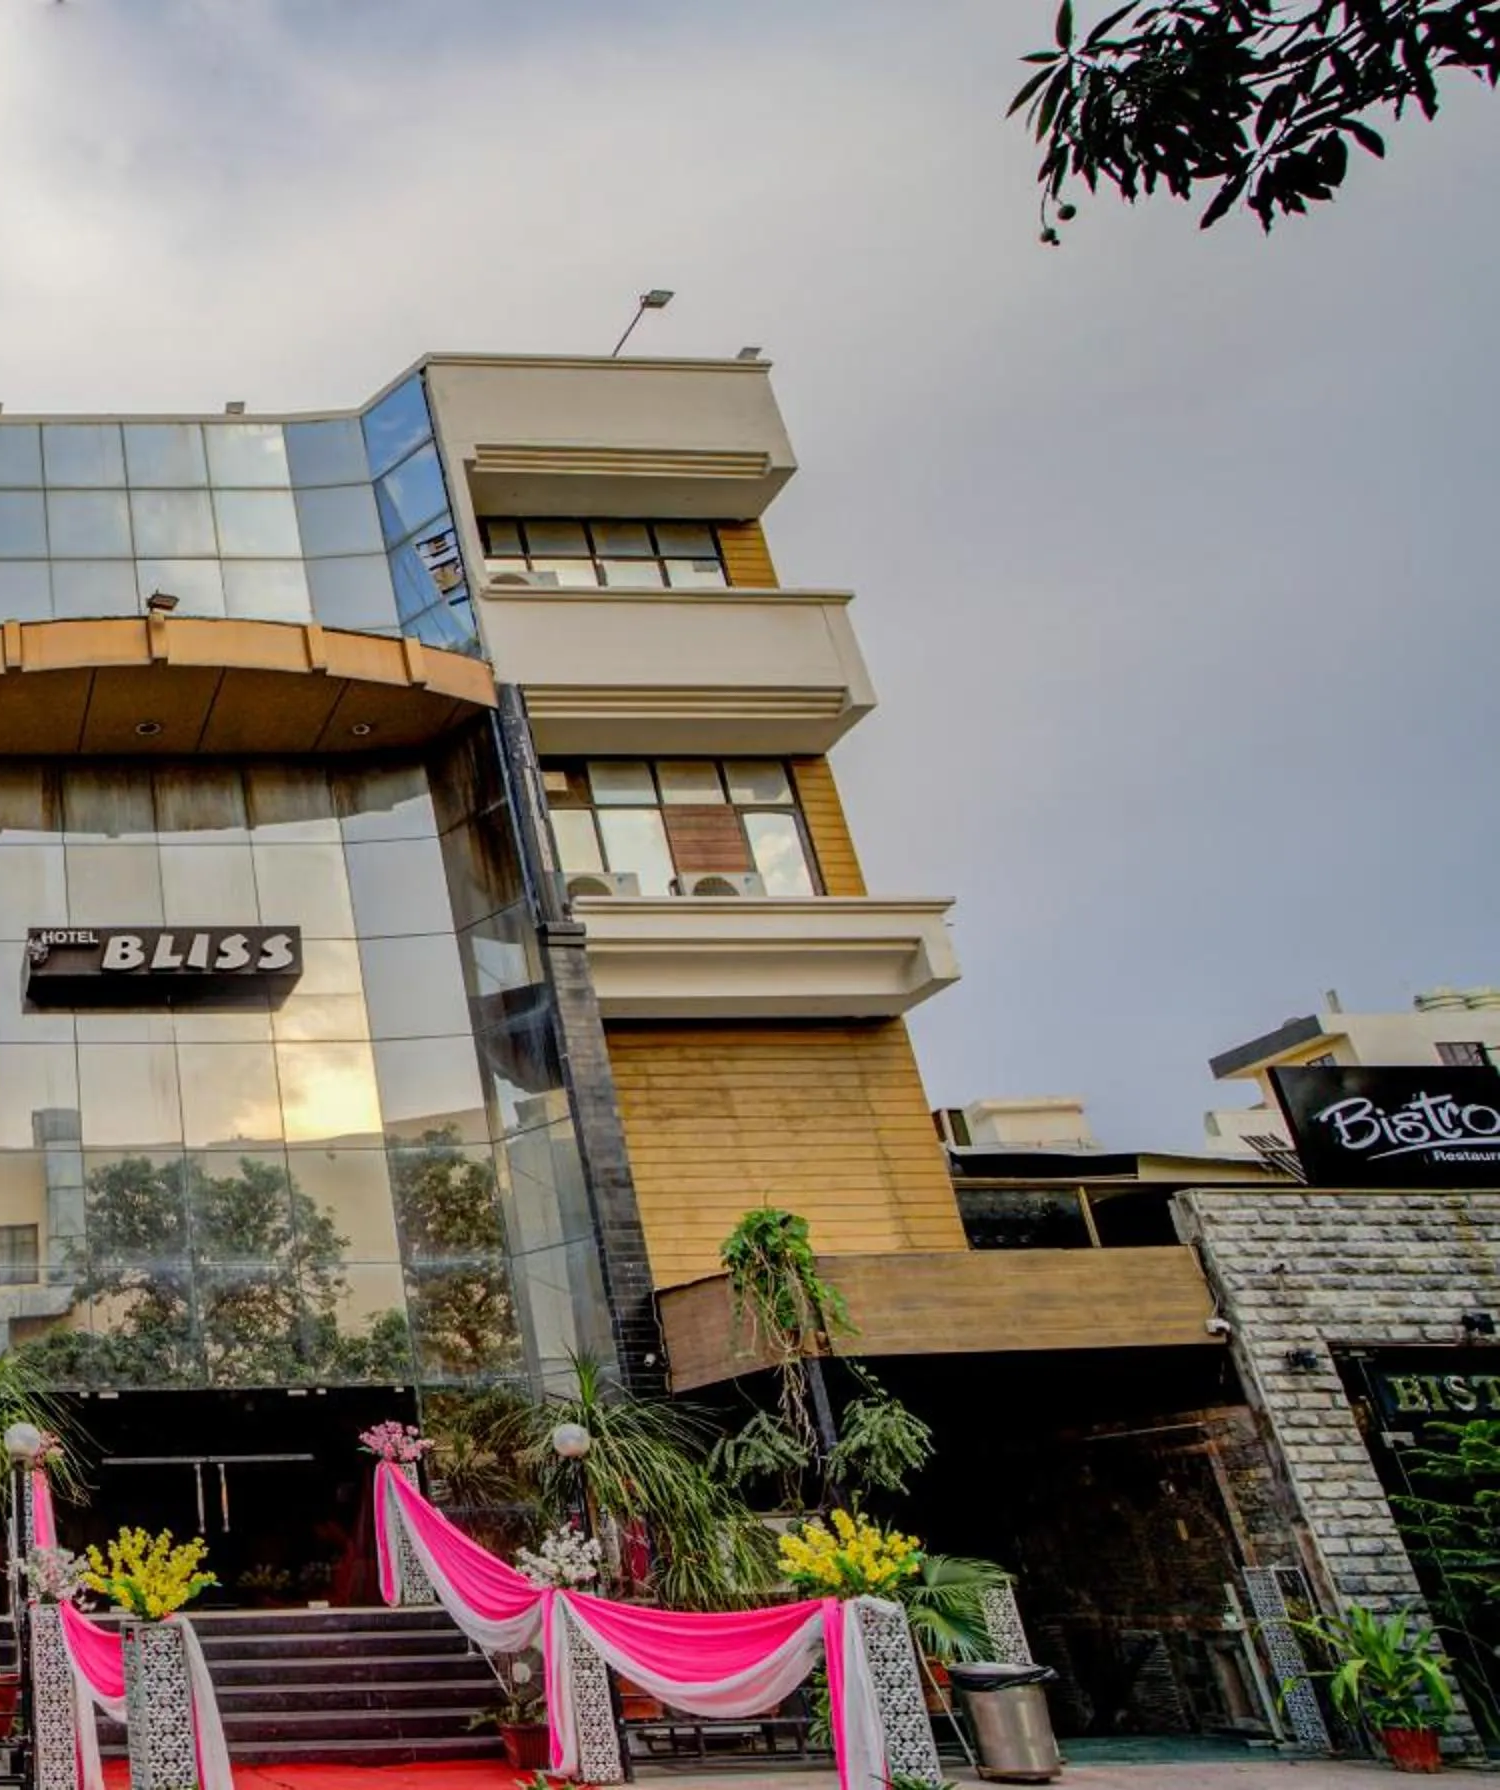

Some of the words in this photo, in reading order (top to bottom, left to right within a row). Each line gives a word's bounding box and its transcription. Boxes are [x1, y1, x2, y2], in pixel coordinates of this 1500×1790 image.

[41, 930, 99, 945] HOTEL
[101, 933, 294, 971] BLISS
[1312, 1091, 1500, 1149] Bistro
[1432, 1150, 1500, 1161] Restaur
